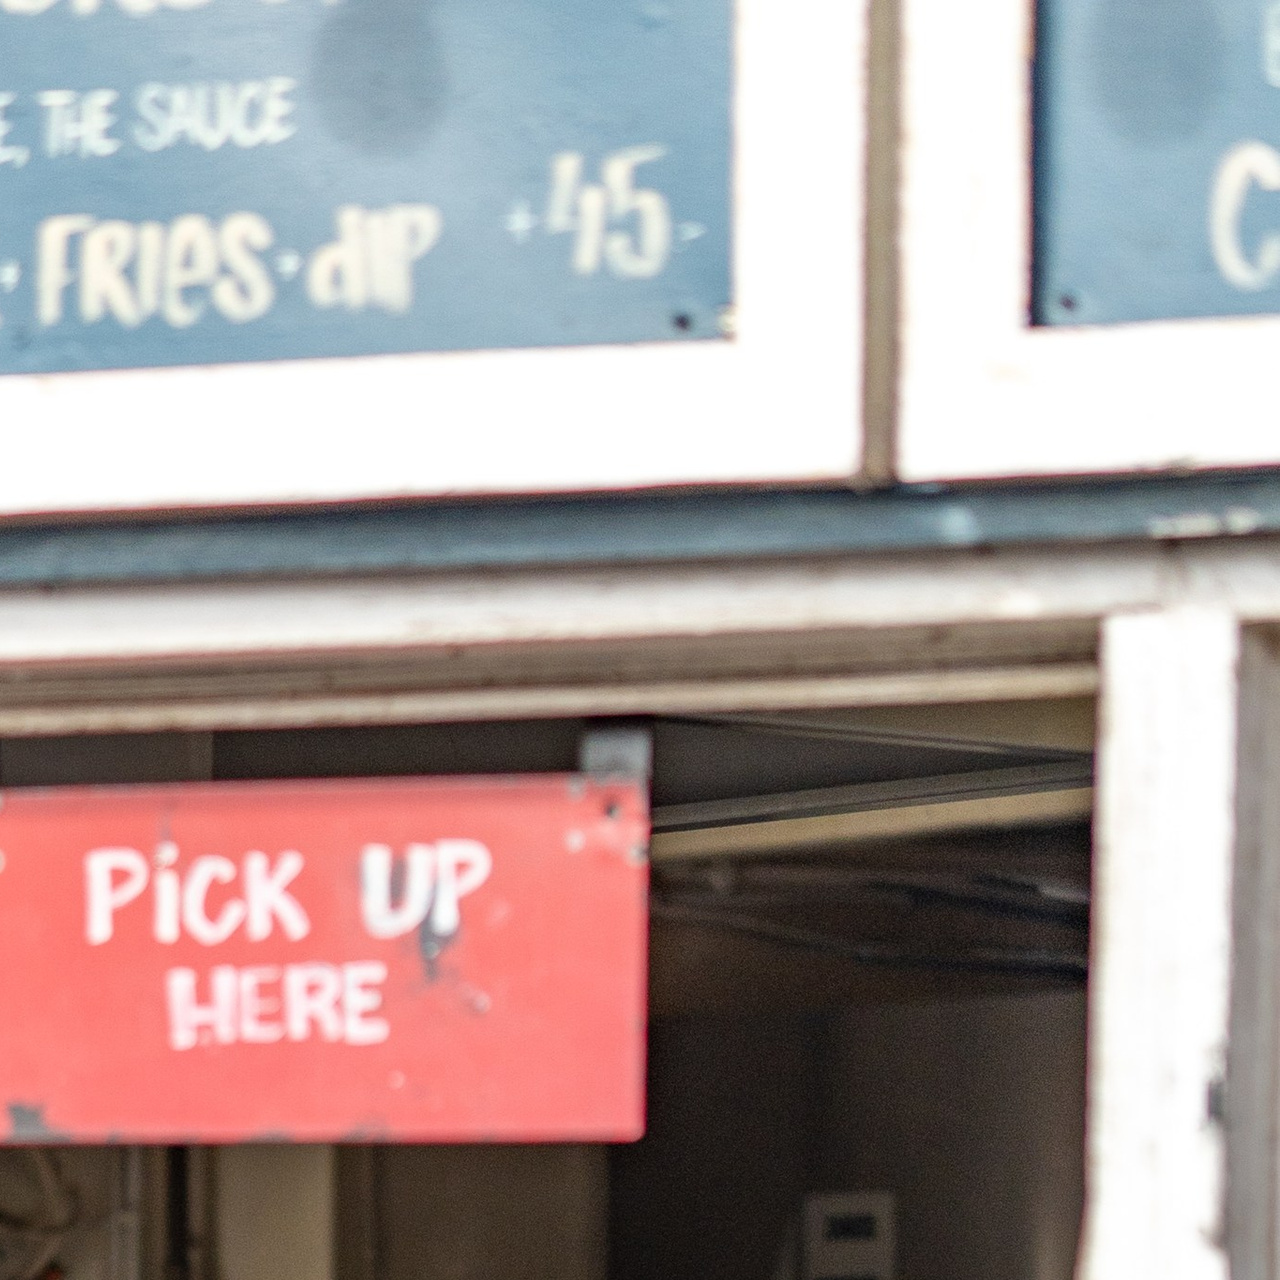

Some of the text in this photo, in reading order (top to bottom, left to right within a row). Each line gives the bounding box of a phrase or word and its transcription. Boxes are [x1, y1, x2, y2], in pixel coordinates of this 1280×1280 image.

[36, 87, 122, 160] THE
[131, 76, 299, 154] SAUCE
[358, 837, 494, 939] UP
[164, 960, 391, 1052] HERE
